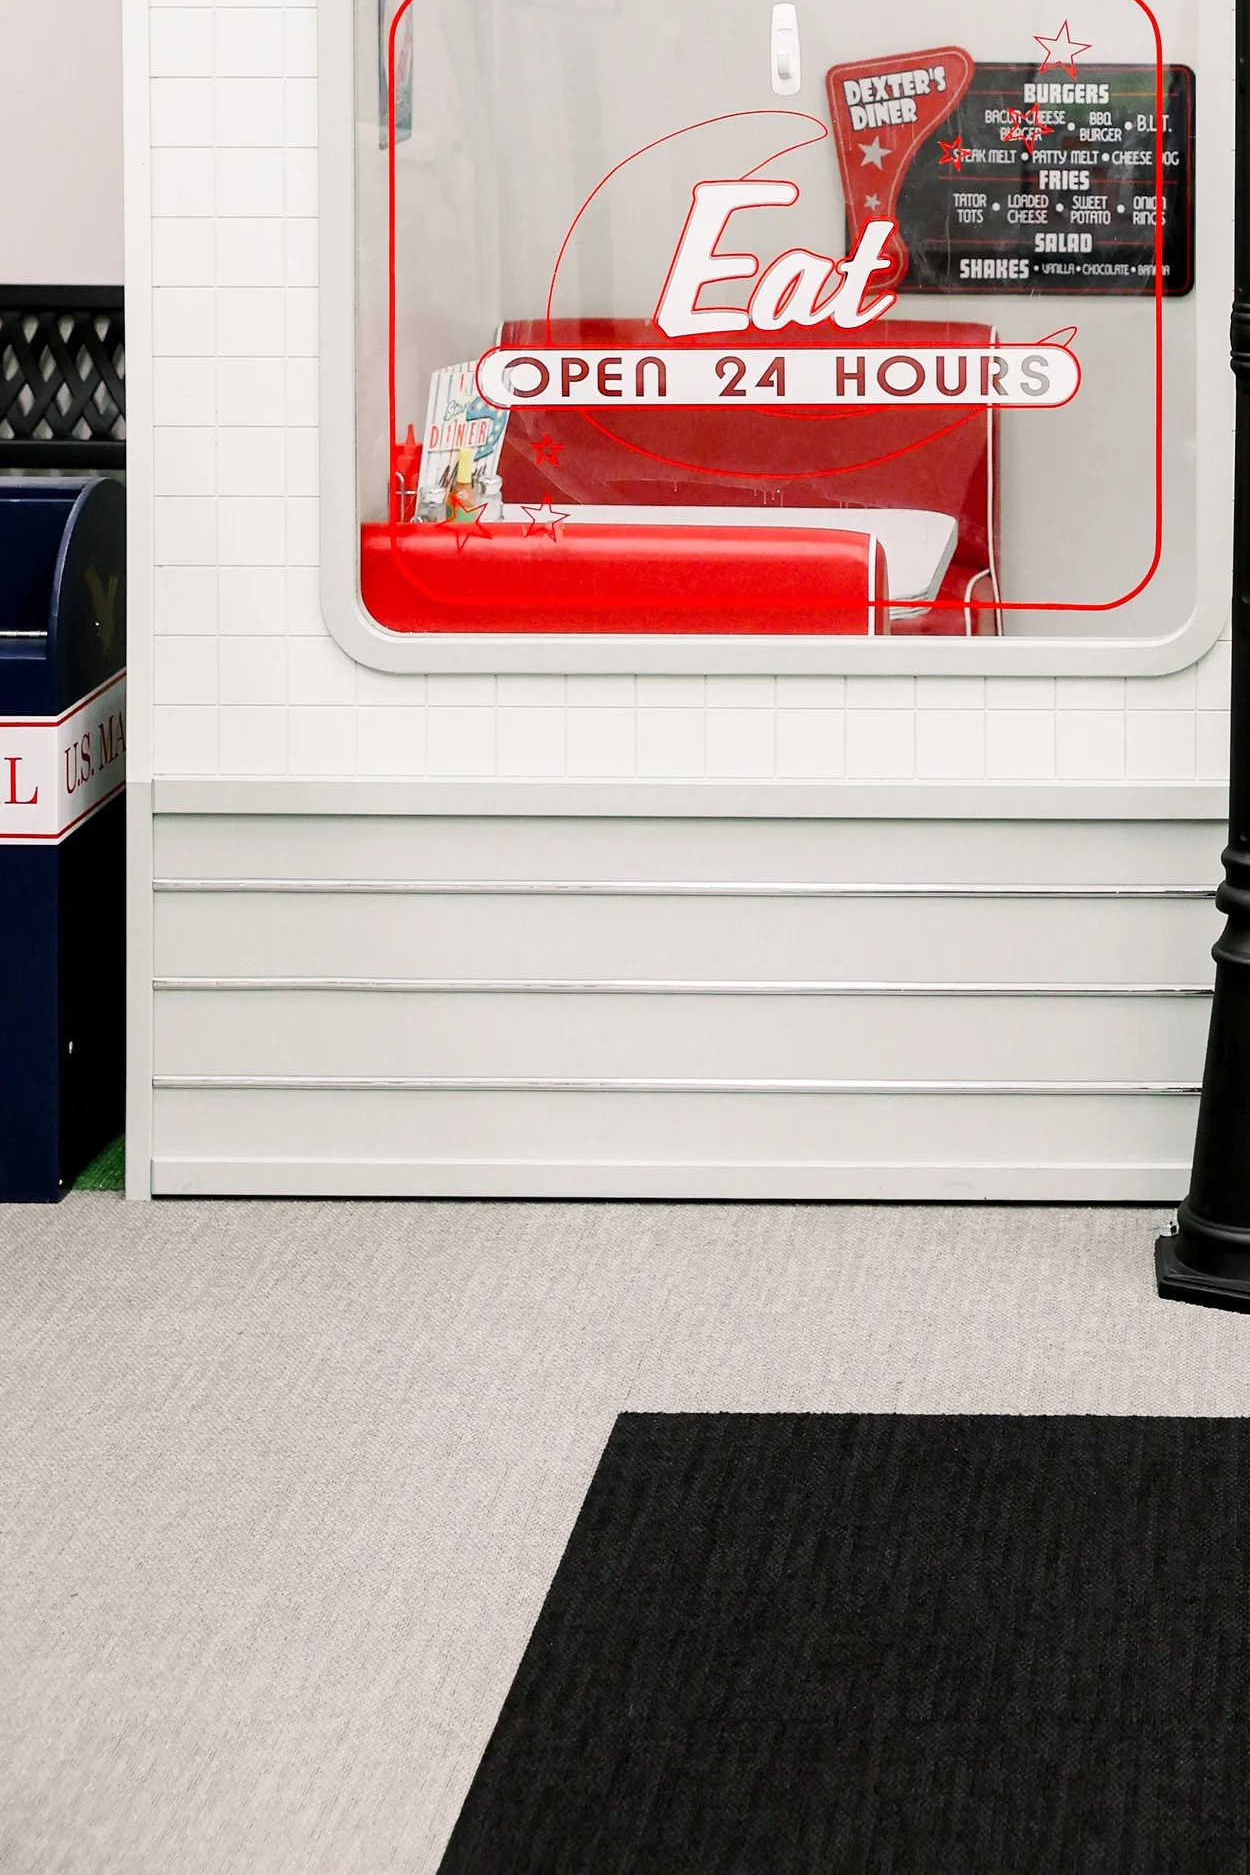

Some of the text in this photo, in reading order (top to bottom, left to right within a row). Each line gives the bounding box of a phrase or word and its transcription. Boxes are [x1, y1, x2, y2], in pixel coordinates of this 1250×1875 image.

[842, 65, 947, 107] DEXTER'S
[1023, 83, 1110, 104] BURGERS
[850, 97, 918, 132] DINER
[1089, 111, 1112, 125] BBQ
[1137, 114, 1172, 132] B.LT.
[1079, 128, 1122, 142] BURGER
[988, 149, 1017, 163] MELT
[1032, 150, 1099, 165] PATTY MELT
[1111, 150, 1179, 166] CHEESE OG
[1039, 170, 1090, 190] FRIES
[953, 193, 987, 208] TATOR
[1008, 194, 1049, 208] LOADED
[1072, 195, 1108, 210] SWEET
[957, 209, 984, 223] TOTS
[1007, 210, 1048, 224] CHEESE
[1070, 210, 1111, 225] POTATO
[1034, 233, 1093, 253] SALAD
[655, 181, 899, 338] Eat
[959, 259, 1170, 279] SHAKES VANILLA CHOCOLATE BANAA
[504, 356, 1050, 397] OPEN 24 HOURS
[429, 421, 488, 450] DINER
[64, 731, 95, 794] U.S.
